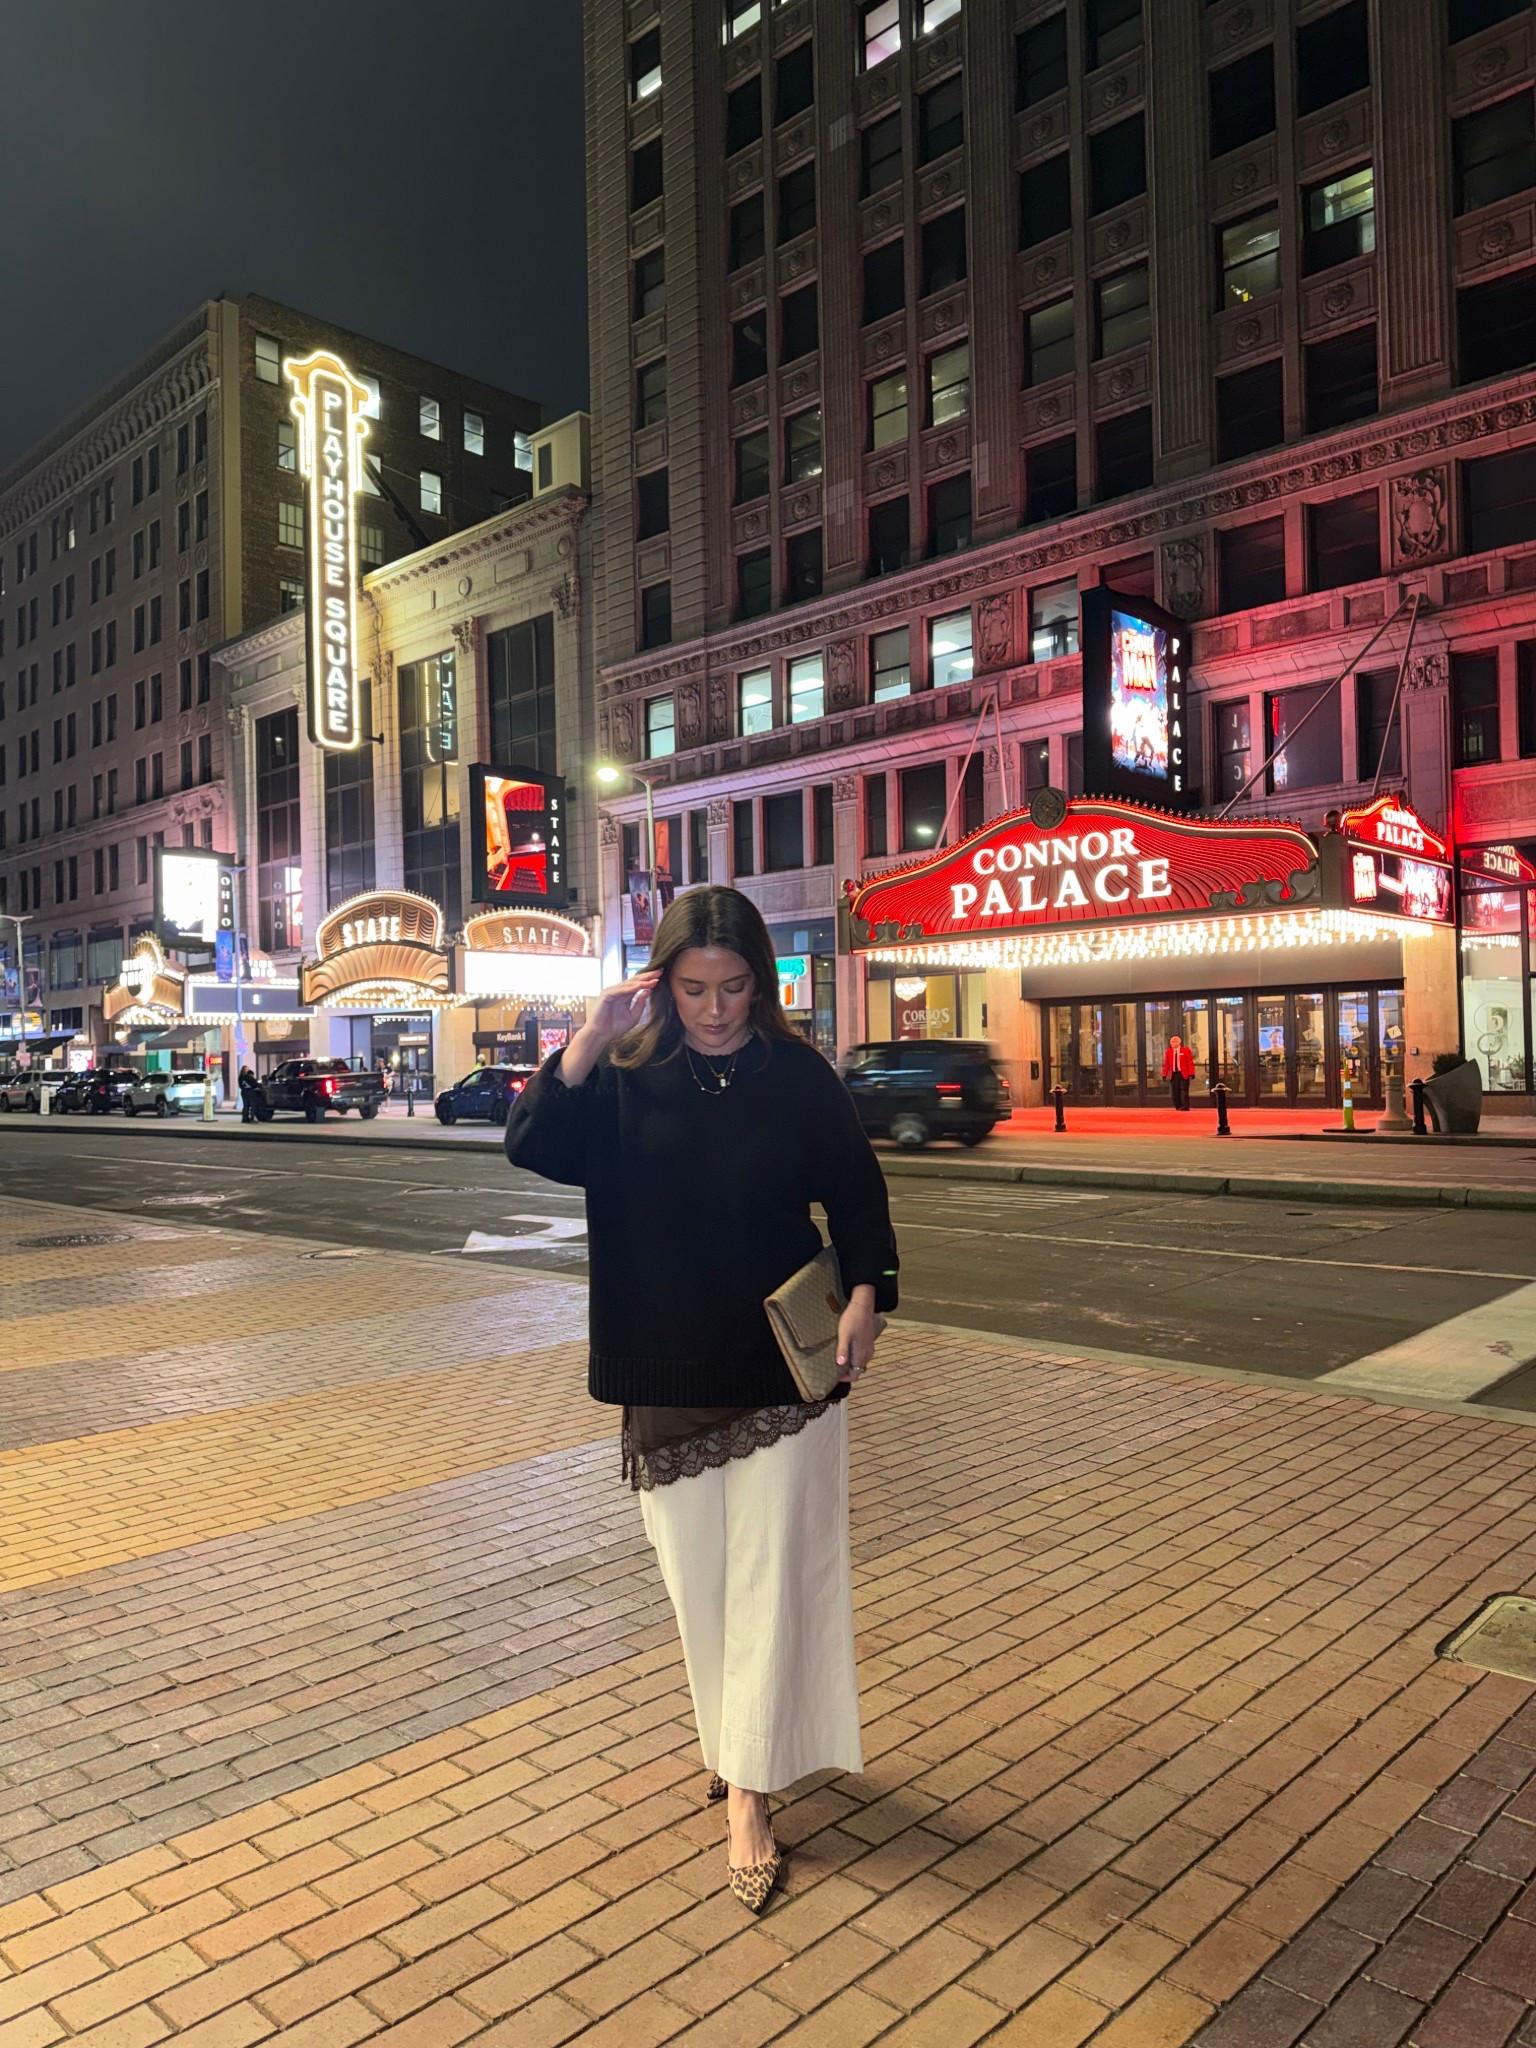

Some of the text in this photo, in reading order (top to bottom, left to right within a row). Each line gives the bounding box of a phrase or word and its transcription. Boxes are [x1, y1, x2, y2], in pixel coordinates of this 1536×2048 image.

[321, 389, 348, 733] PLAYHOUSE SQUARE
[1172, 637, 1182, 792] PALACE
[550, 798, 560, 883] STATE
[1376, 821, 1425, 851] PALACE
[1382, 807, 1418, 830] CONNOR
[973, 828, 1140, 875] CONNOR
[220, 876, 232, 927] OHIO
[951, 858, 1172, 919] PALACE
[342, 916, 401, 948] STATE
[503, 926, 560, 947] STATE
[496, 1032, 522, 1043] KeyBank
